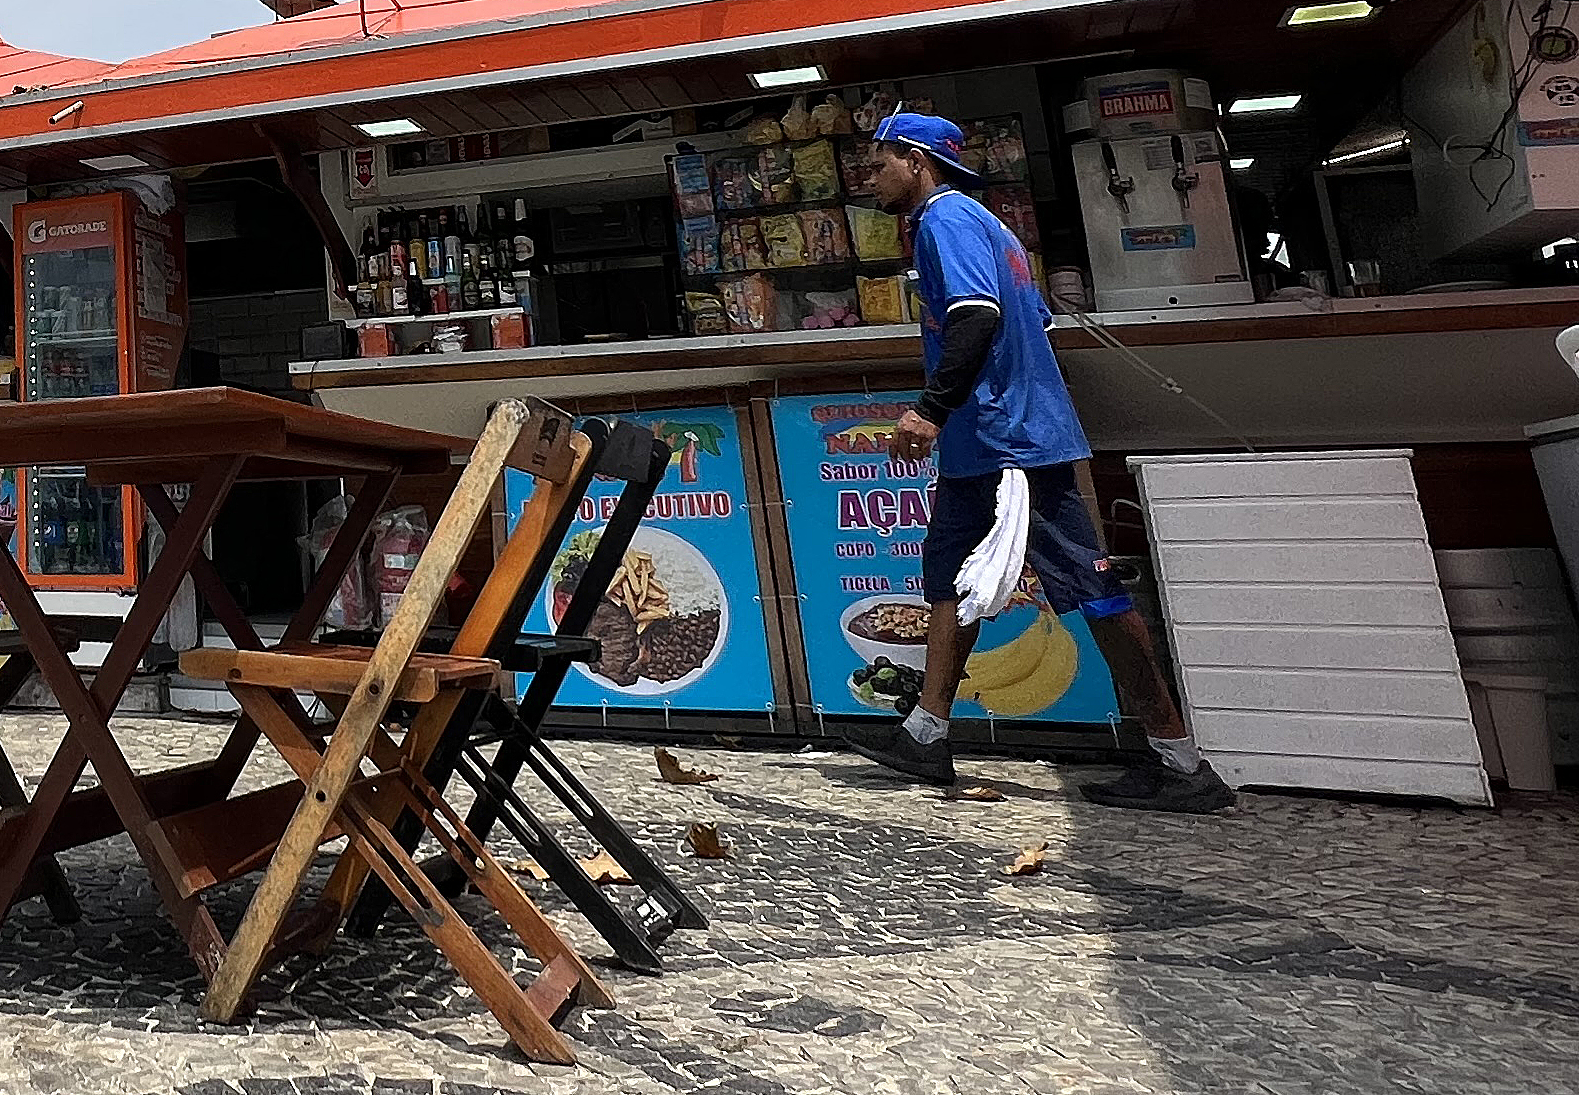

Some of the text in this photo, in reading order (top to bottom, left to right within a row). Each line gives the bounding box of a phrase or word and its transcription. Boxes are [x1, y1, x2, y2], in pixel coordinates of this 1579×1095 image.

[1103, 93, 1170, 116] BRAHMA
[48, 220, 107, 238] GATORADE
[820, 461, 878, 481] Sabor
[835, 542, 875, 557] COPO
